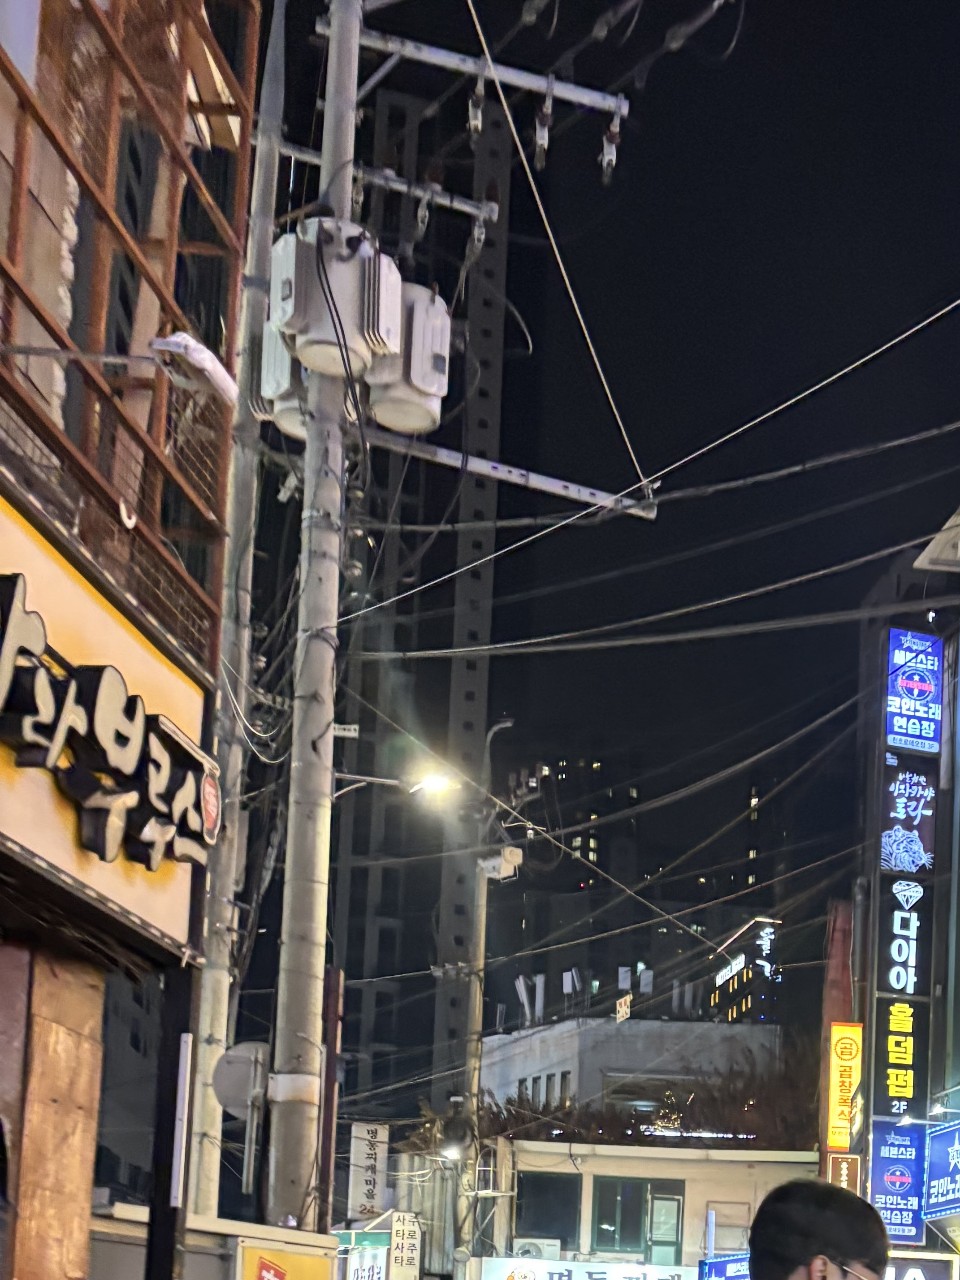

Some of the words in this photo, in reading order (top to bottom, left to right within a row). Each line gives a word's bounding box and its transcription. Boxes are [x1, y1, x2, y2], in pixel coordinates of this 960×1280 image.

[893, 649, 939, 671] 세븐스타
[887, 695, 942, 720] 코인노래
[893, 715, 936, 738] 연습장
[889, 910, 920, 994] 다이아
[886, 1002, 914, 1099] 홀덤펍
[891, 1101, 908, 1113] 2F
[875, 1195, 918, 1210] 코인노래
[395, 1214, 420, 1228] 사주
[395, 1229, 418, 1241] 타로
[394, 1242, 418, 1255] 사주
[394, 1256, 416, 1267] 타로
